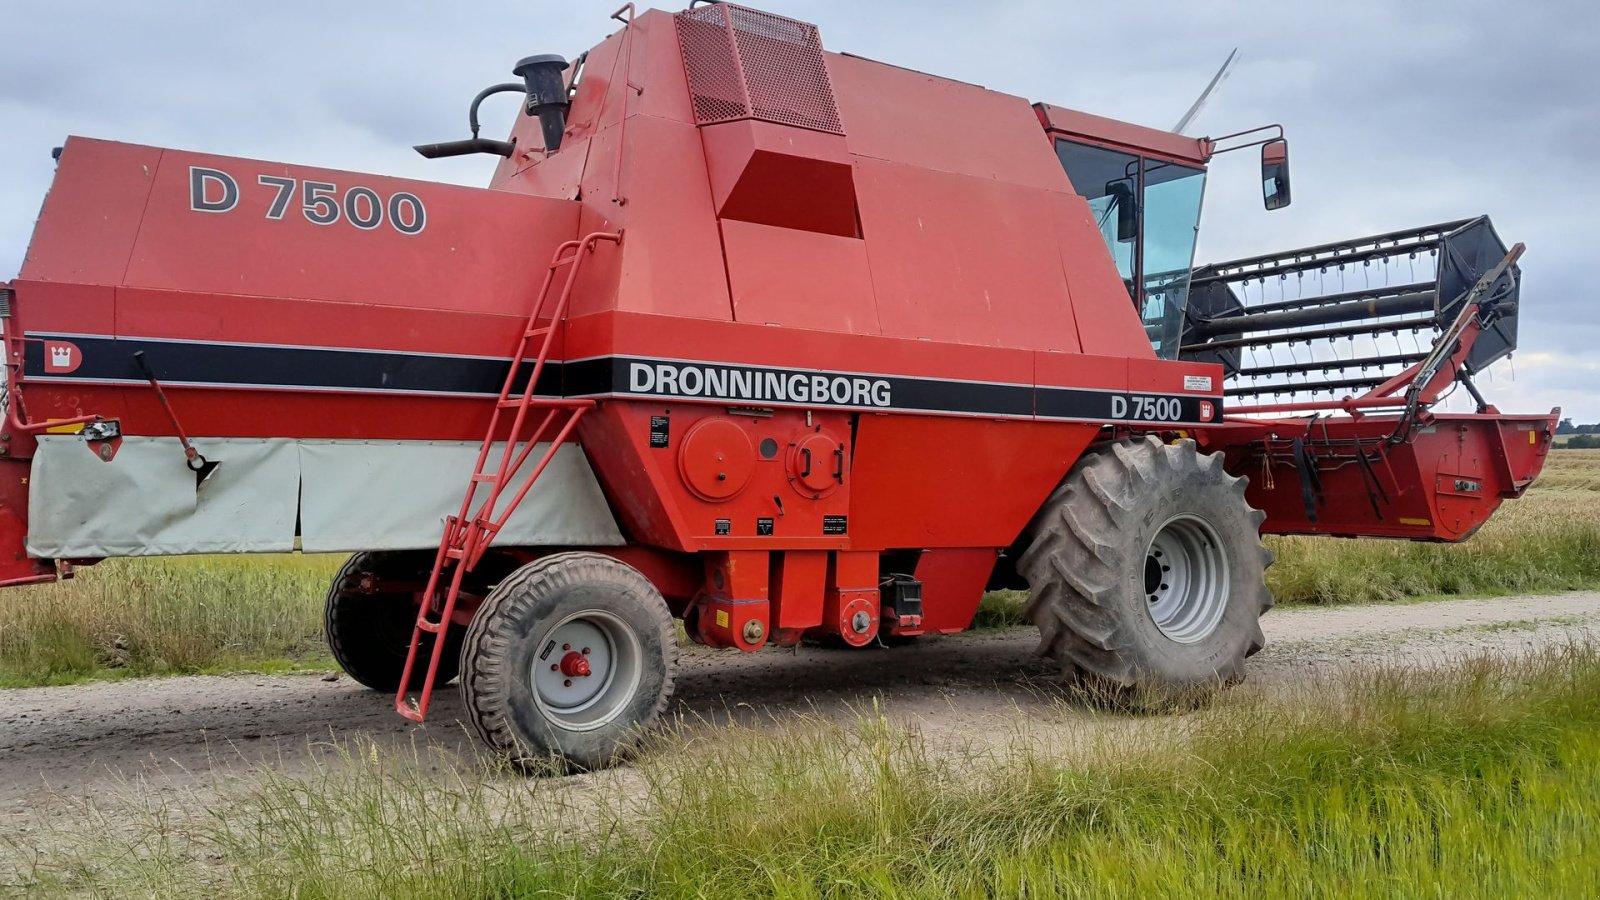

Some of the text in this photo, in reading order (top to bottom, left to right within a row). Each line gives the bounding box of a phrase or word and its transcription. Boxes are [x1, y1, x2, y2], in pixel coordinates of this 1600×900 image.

[189, 165, 427, 235] D 7500
[630, 362, 891, 407] DRONNINGBORG
[1111, 395, 1182, 421] D 7500
